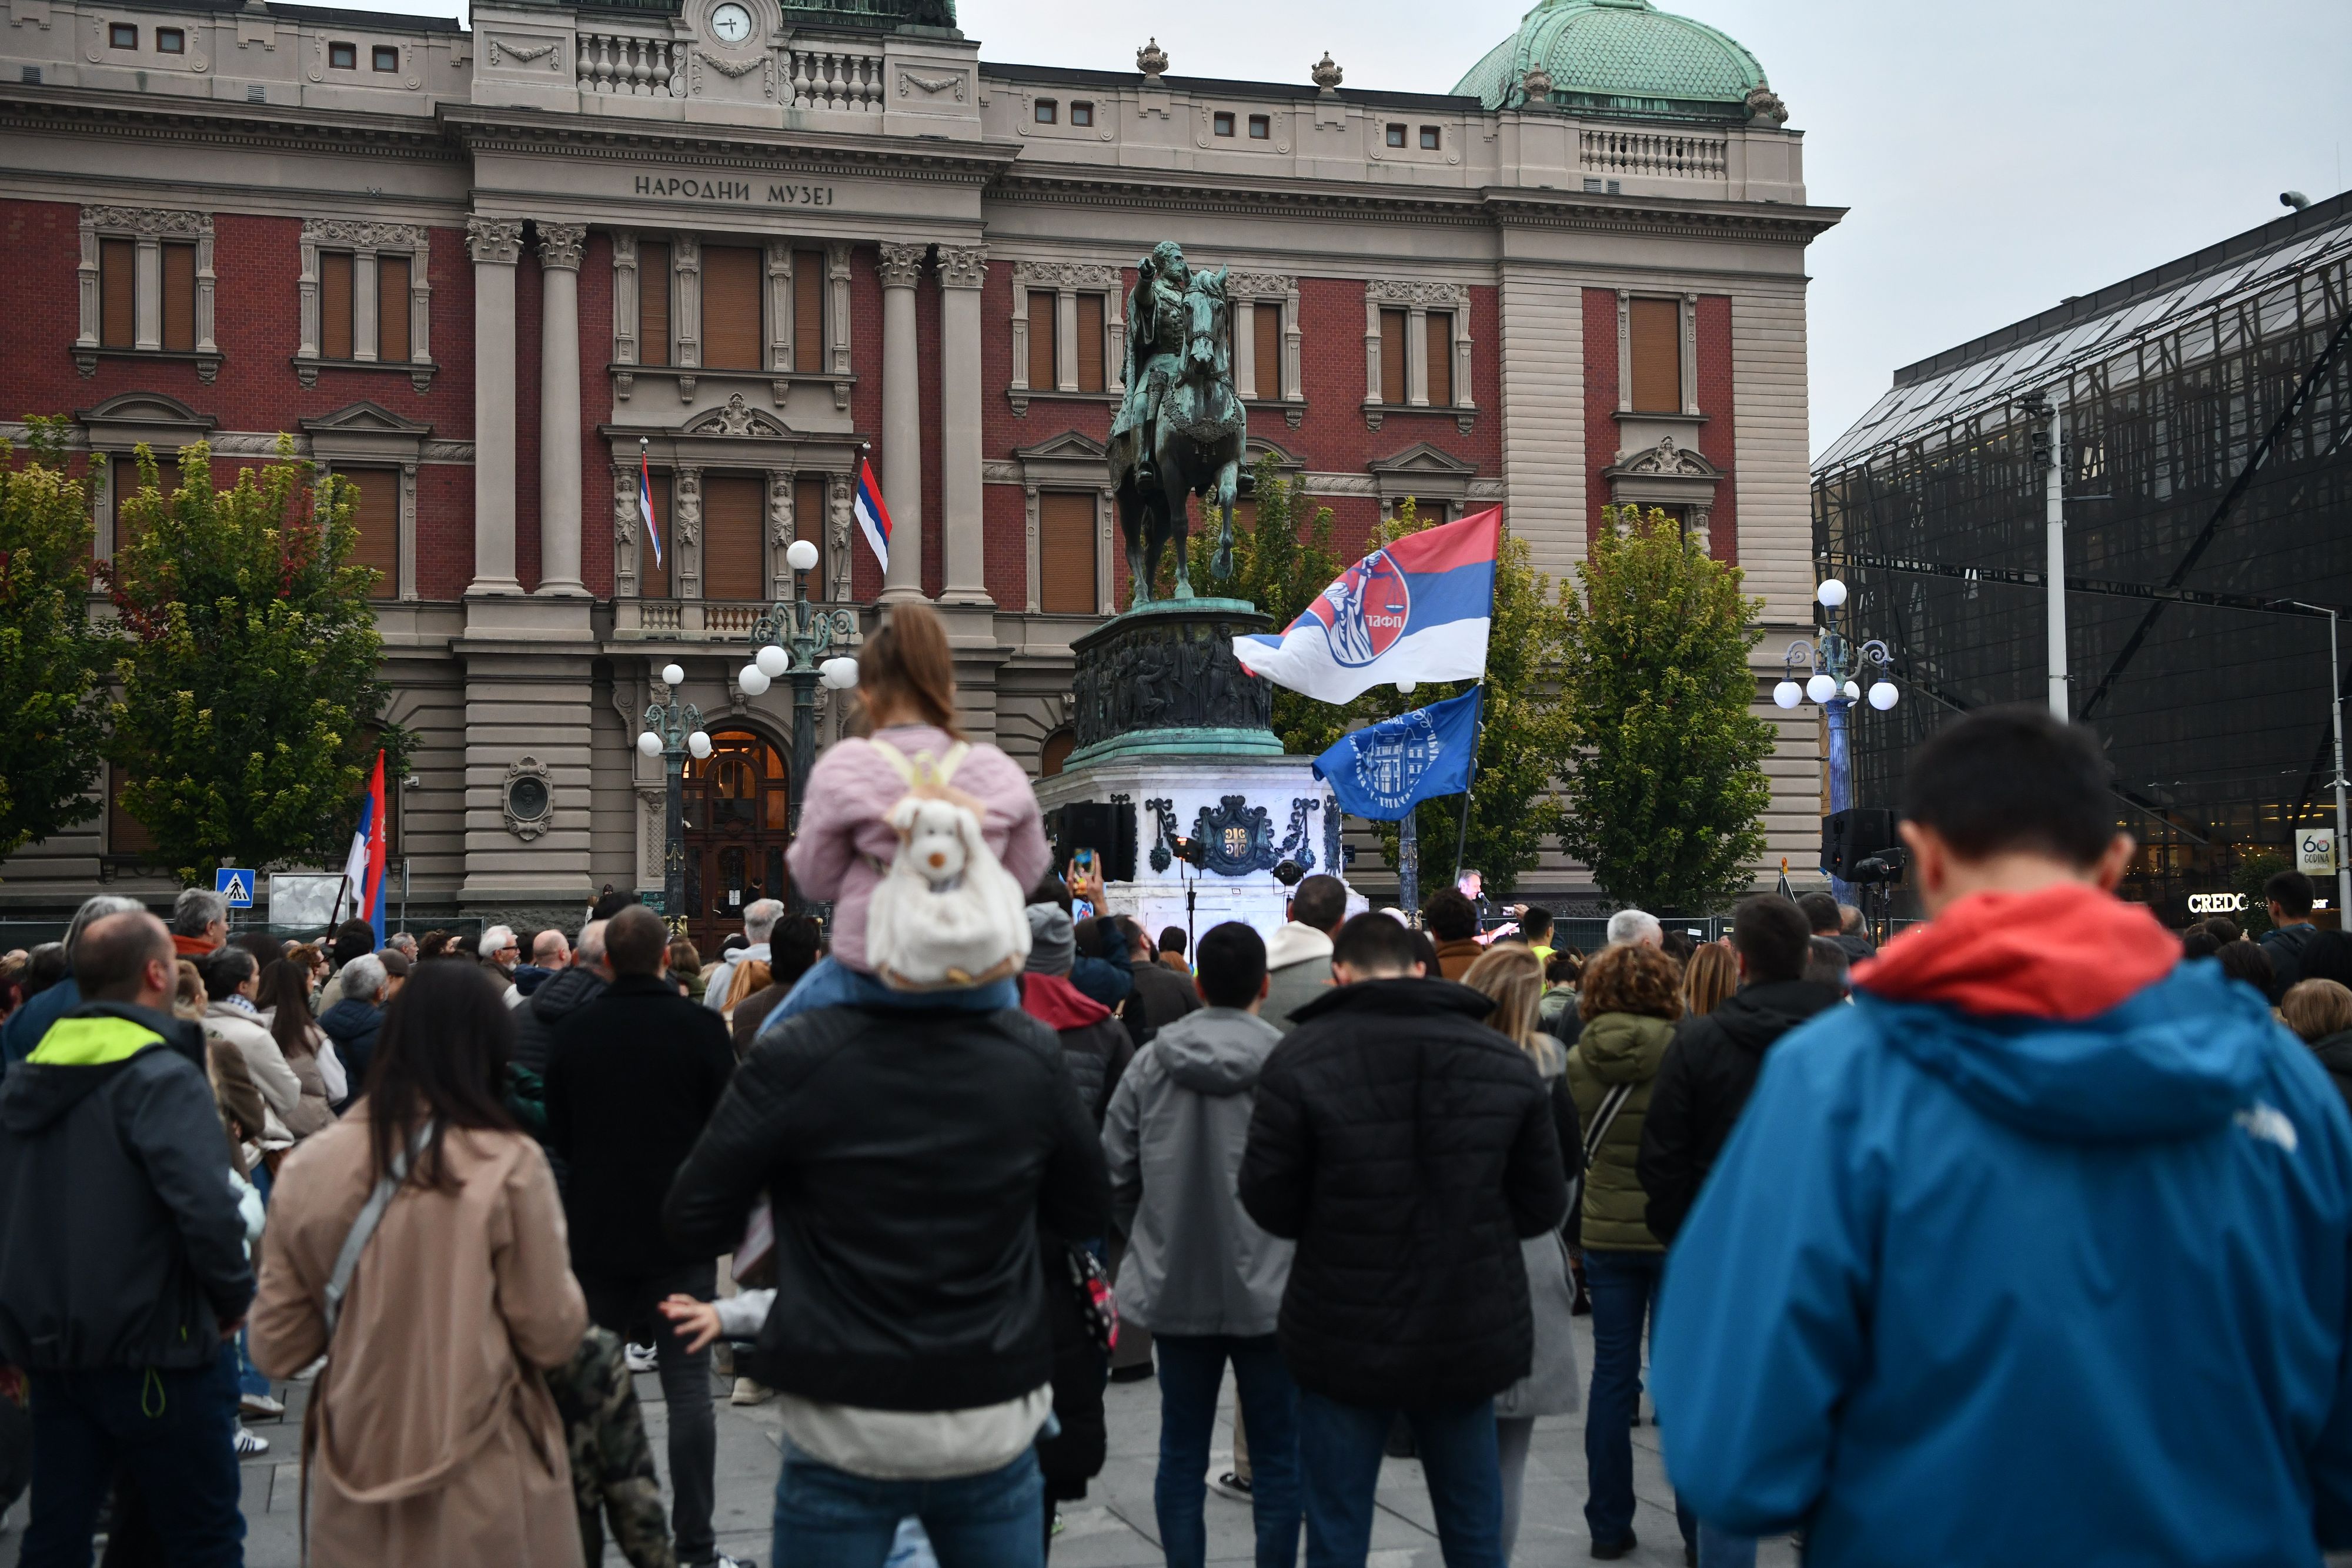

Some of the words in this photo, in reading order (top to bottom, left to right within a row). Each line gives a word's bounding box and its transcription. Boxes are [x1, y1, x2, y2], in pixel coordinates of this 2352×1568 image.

[635, 176, 749, 200] НАРОДНИ
[767, 184, 833, 205] МУЗЕЈ
[2303, 835, 2330, 852] 60
[2304, 854, 2330, 863] GODINA
